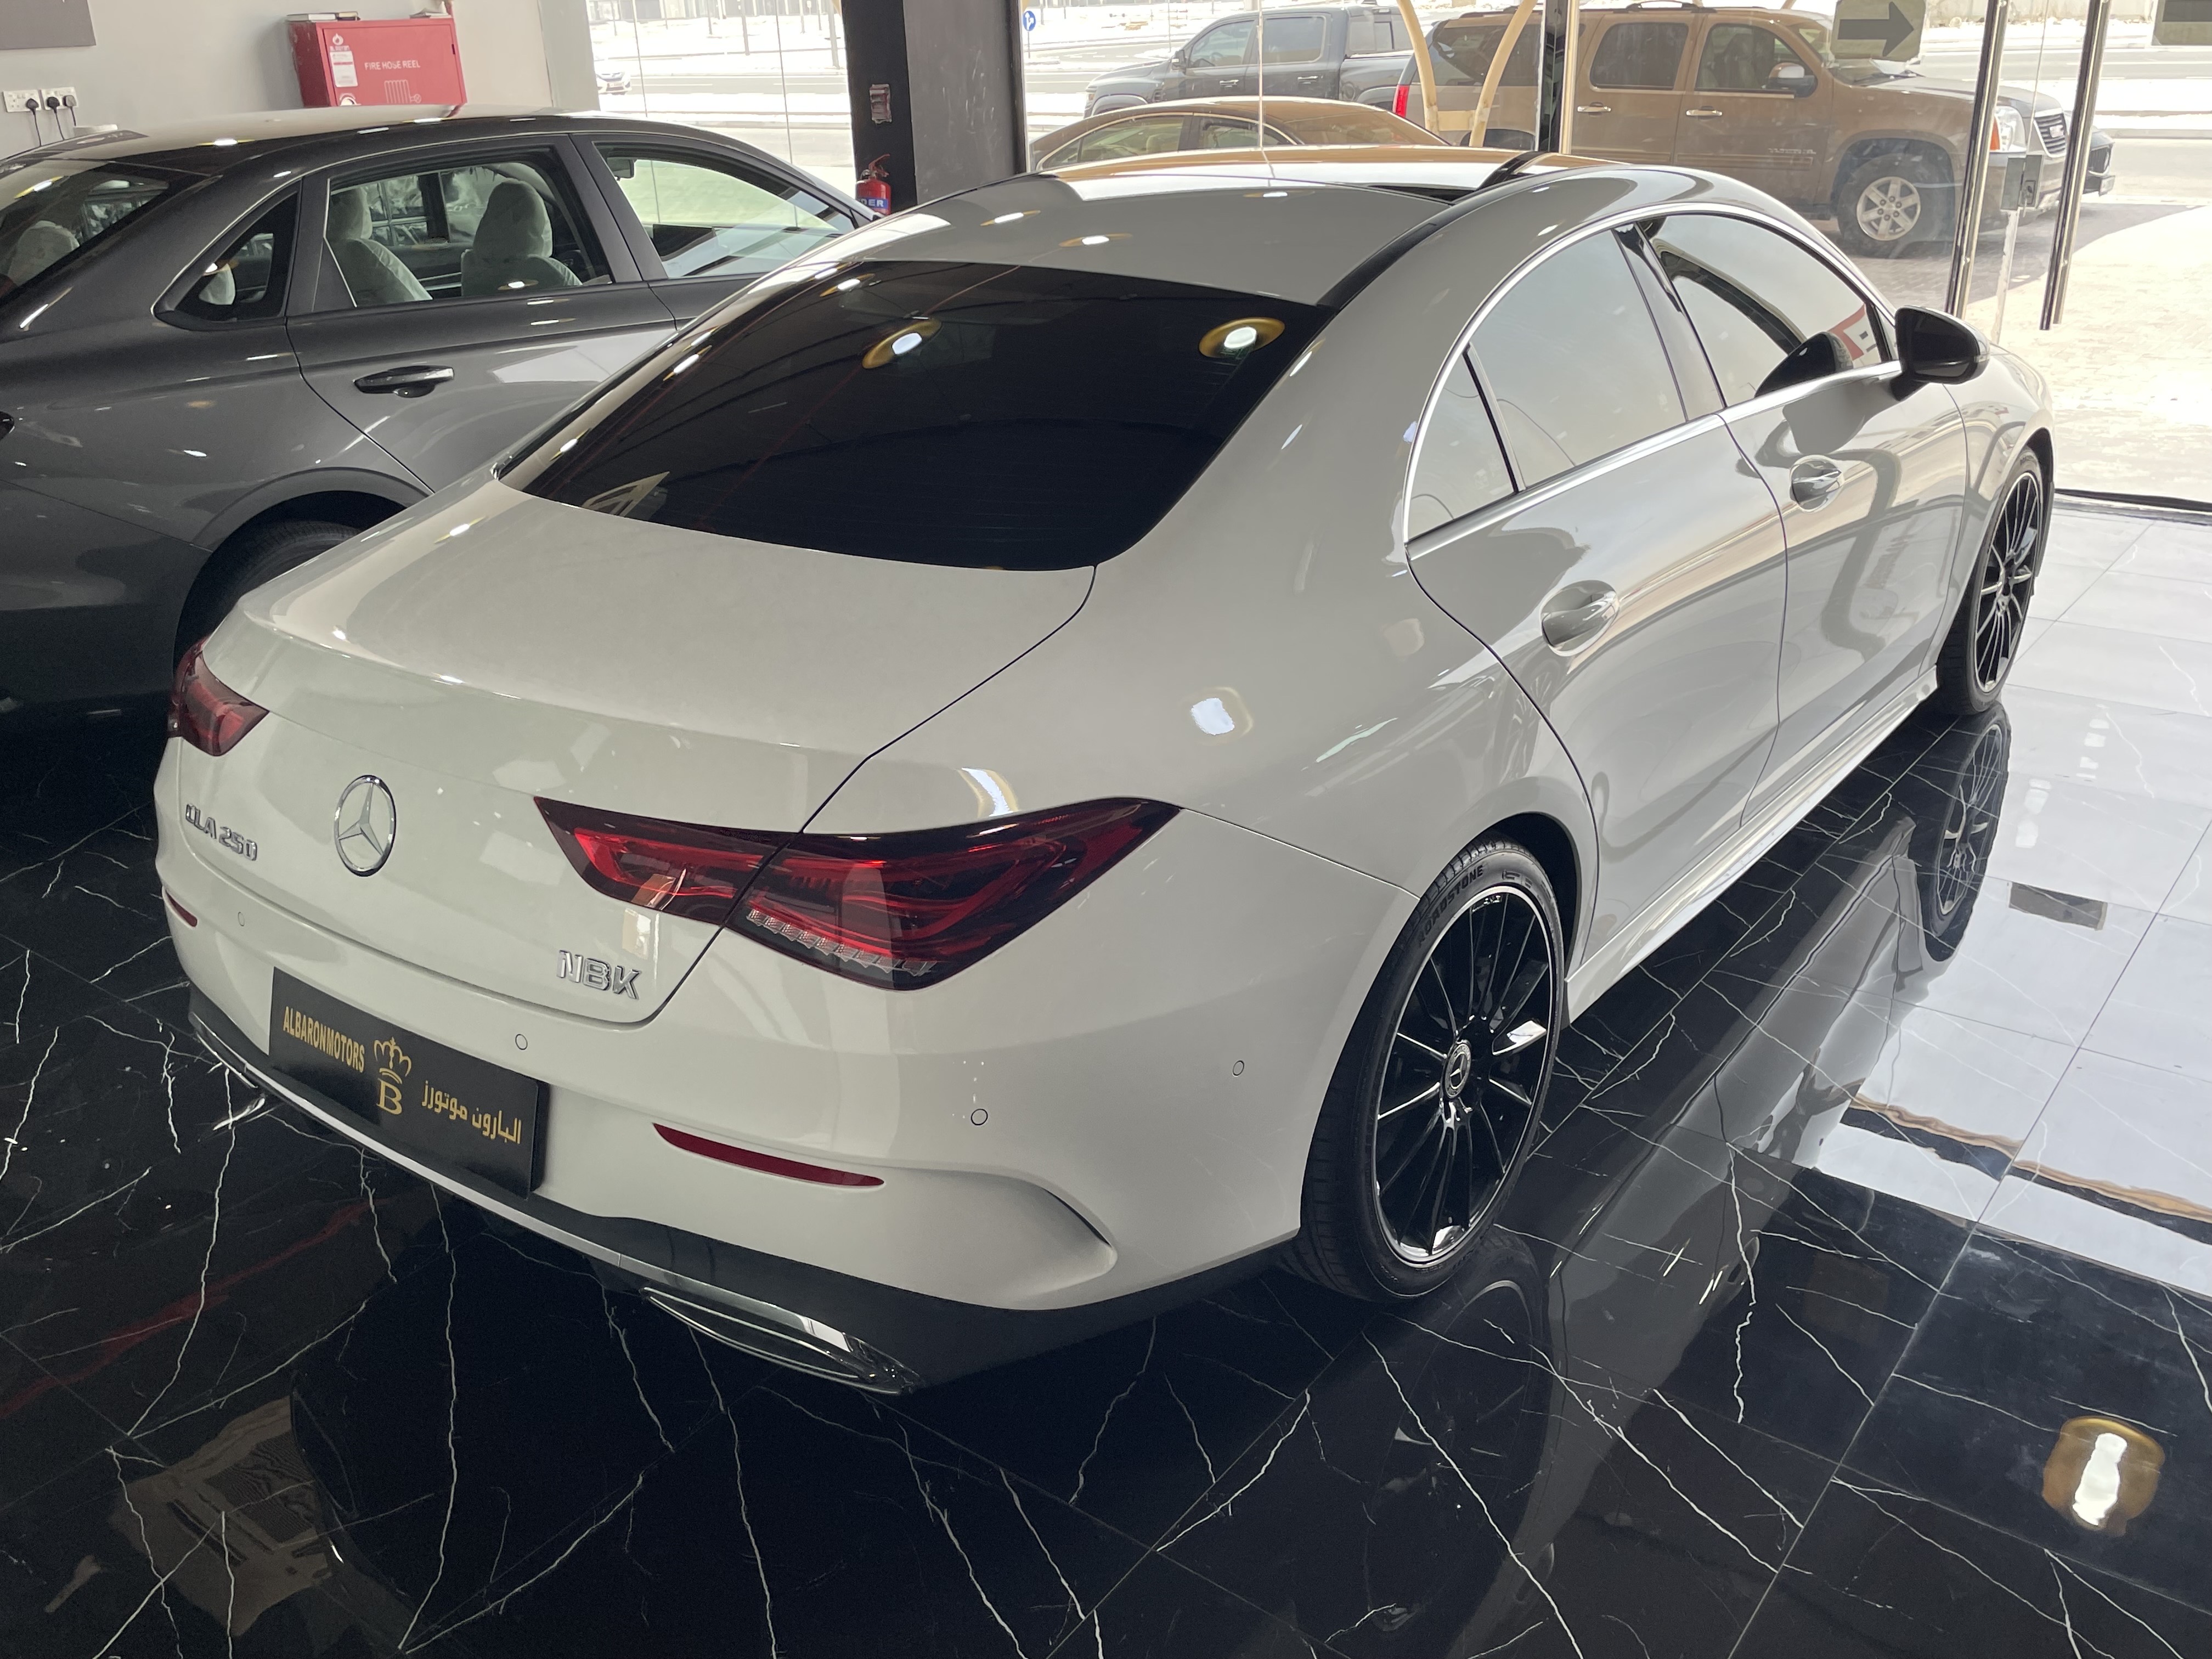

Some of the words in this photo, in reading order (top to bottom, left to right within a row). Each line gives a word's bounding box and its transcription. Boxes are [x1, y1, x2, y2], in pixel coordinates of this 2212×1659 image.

[364, 62, 381, 70] FIRE
[382, 61, 402, 69] HOSE
[402, 60, 421, 69] REEL
[219, 826, 257, 861] 250
[556, 950, 642, 1000] NBK
[376, 1078, 402, 1115] B
[421, 1080, 467, 1120] موتورز
[472, 1107, 522, 1144] البارون
